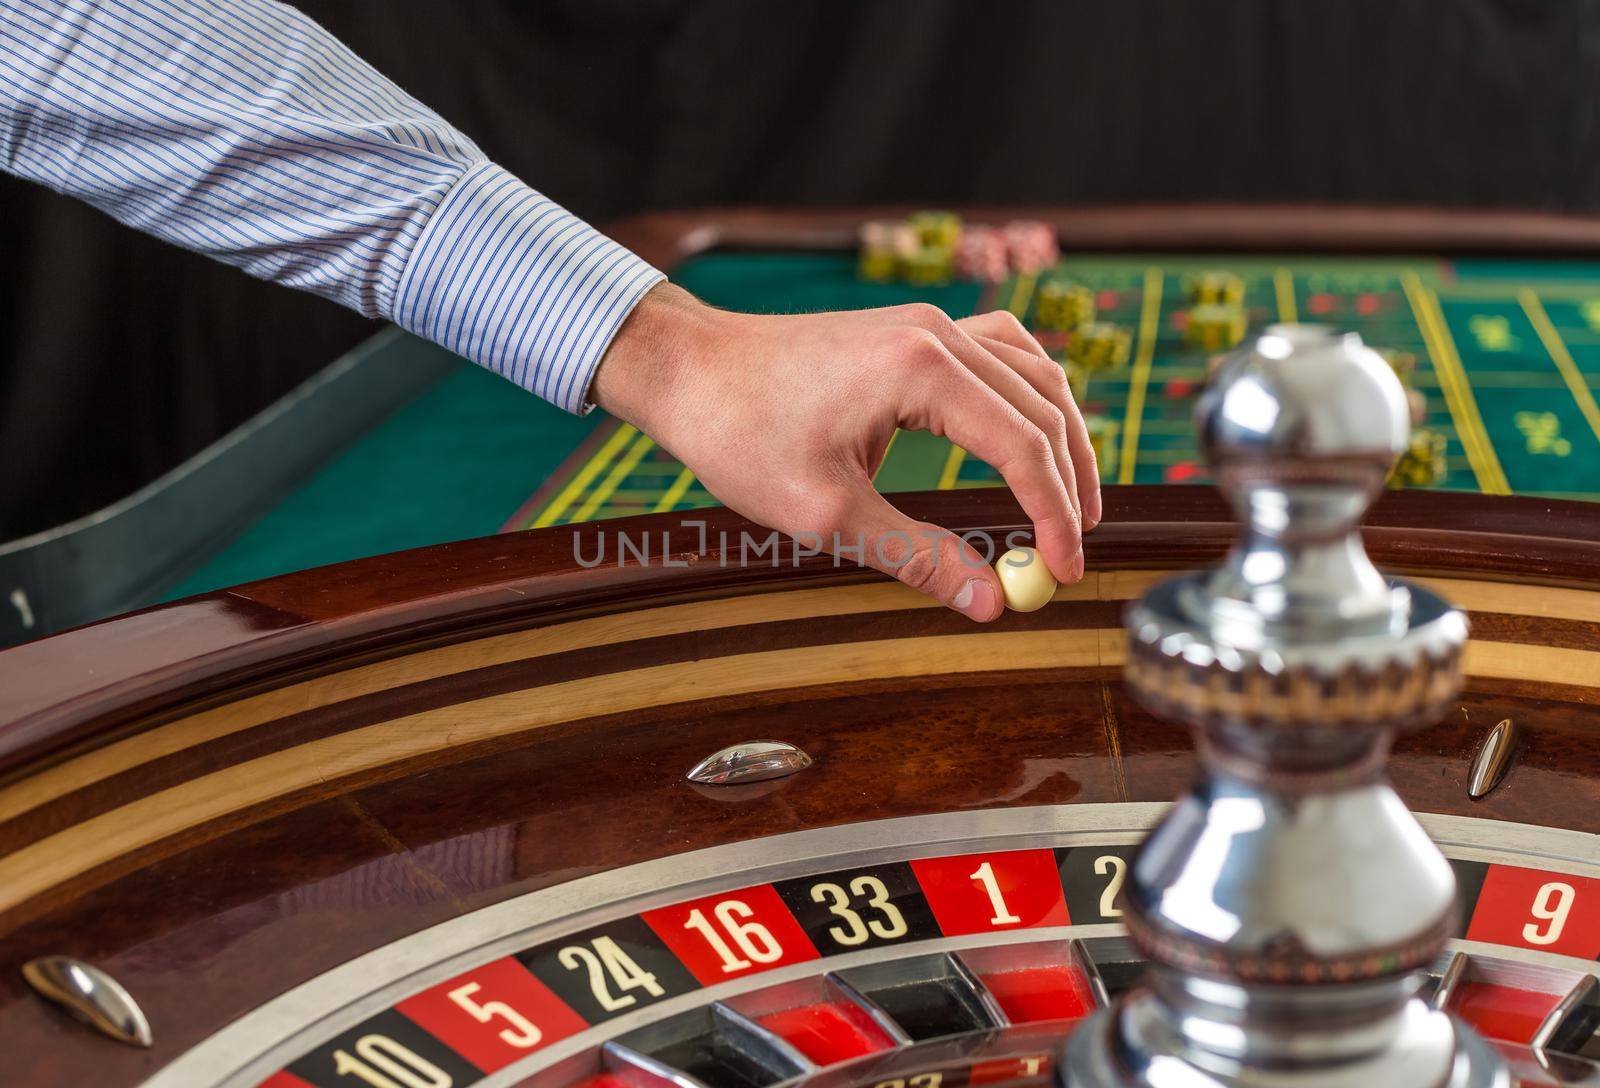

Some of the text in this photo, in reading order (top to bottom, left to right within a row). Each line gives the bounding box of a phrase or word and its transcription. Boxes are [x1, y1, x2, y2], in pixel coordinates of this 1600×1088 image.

[809, 875, 909, 947] 33
[969, 861, 1021, 927] 1
[1094, 855, 1127, 917] 2
[1521, 881, 1577, 946] 9
[682, 899, 784, 974] 16
[557, 935, 667, 1013] 24
[447, 981, 543, 1048] 5
[333, 1034, 453, 1088] 10
